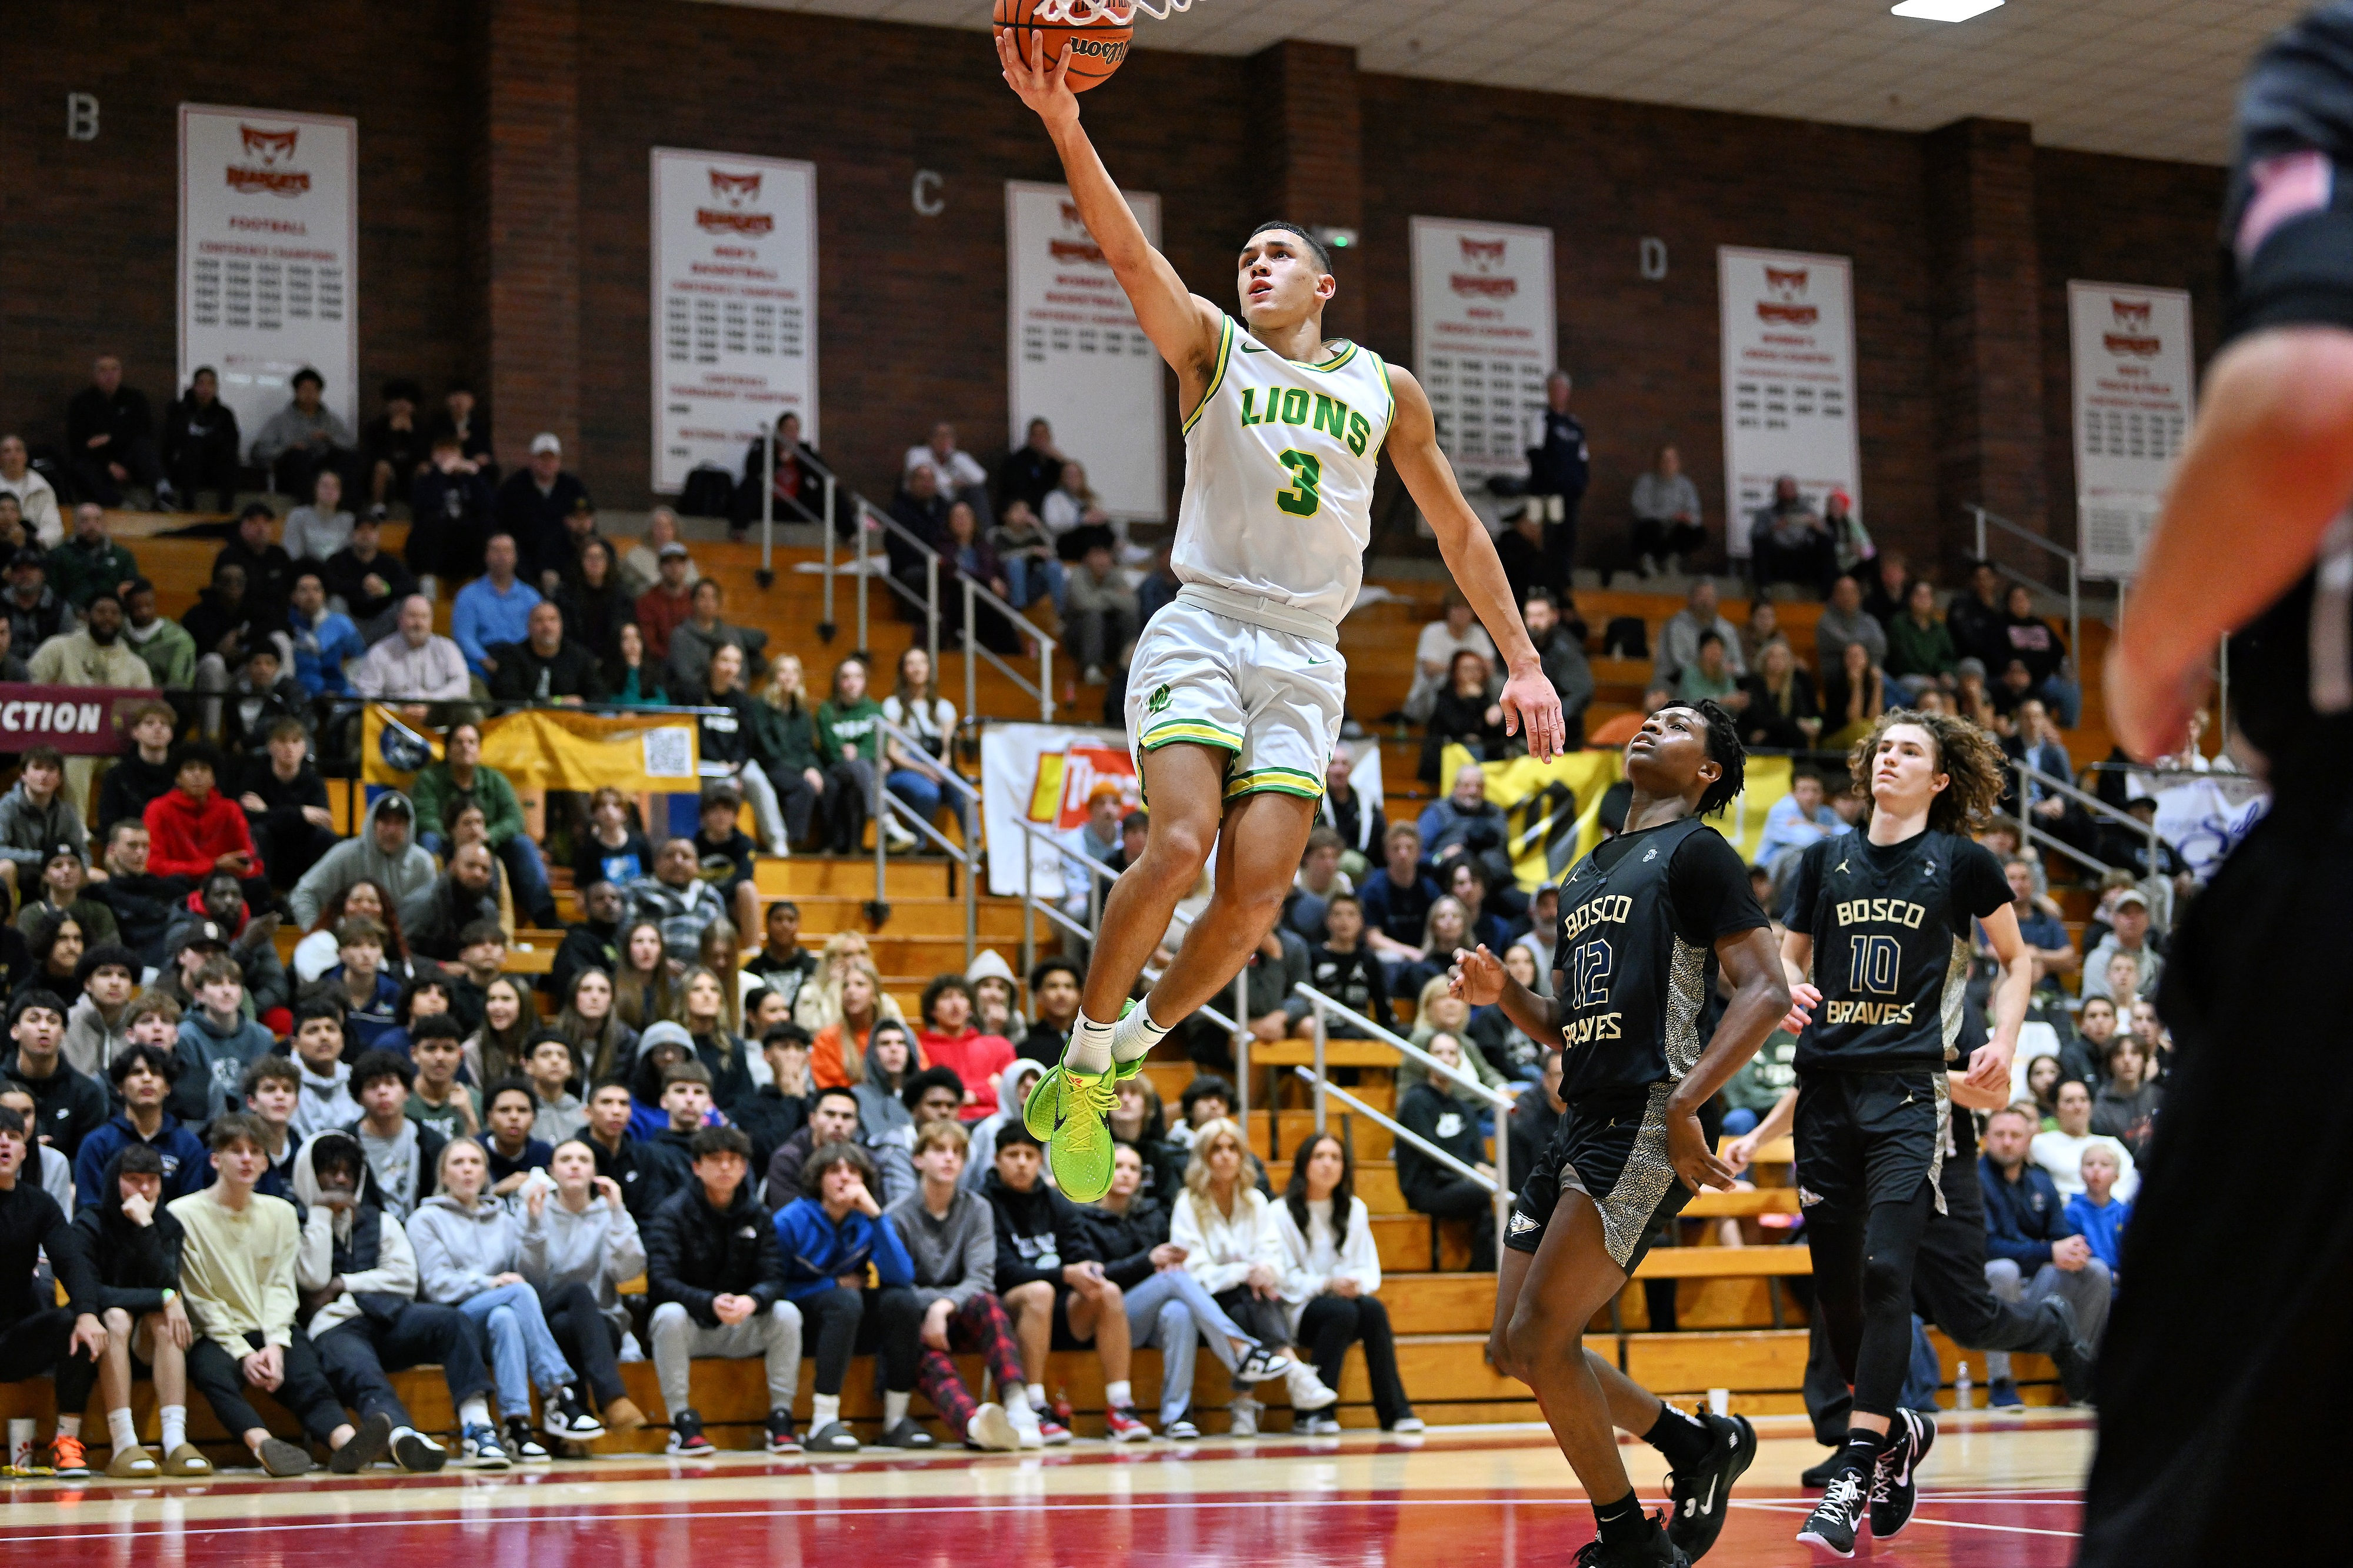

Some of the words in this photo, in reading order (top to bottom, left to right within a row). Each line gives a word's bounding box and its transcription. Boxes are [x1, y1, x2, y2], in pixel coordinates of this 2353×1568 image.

[67, 92, 100, 141] B
[912, 168, 945, 217] C
[1241, 386, 1371, 458] LIONS
[1276, 447, 1322, 519] 3
[0, 700, 102, 734] CTION
[1565, 895, 1632, 940] BOSCO
[1836, 898, 1925, 930] BOSCO
[1572, 938, 1612, 1010] 12
[1849, 935, 1901, 995] 10
[1562, 1013, 1622, 1050] BRAVES
[1827, 1000, 1915, 1026] BRAVES
